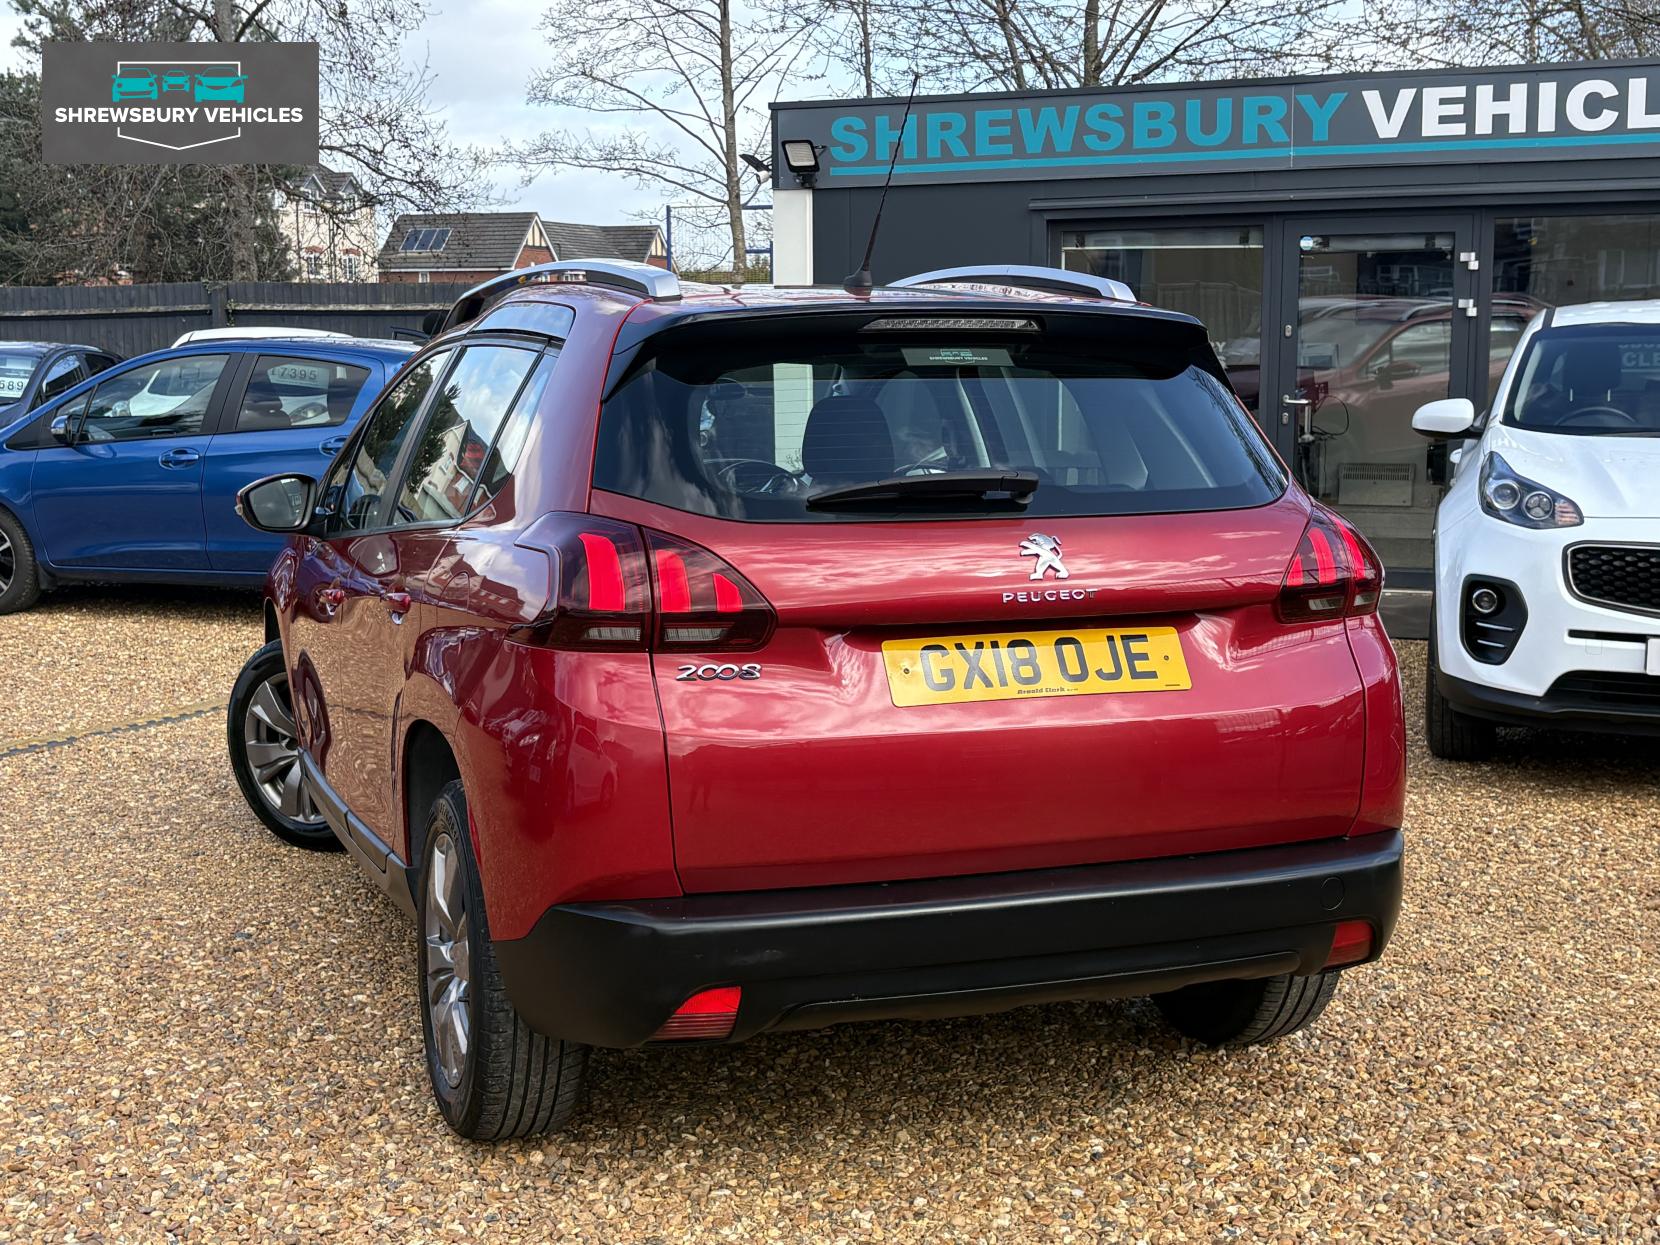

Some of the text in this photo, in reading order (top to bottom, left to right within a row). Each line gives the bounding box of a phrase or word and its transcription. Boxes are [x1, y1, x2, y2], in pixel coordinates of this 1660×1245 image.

[830, 77, 1660, 163] SHREWSBURY VEHICL
[1003, 588, 1098, 604] PEUGEOT
[676, 663, 762, 681] 2008
[919, 633, 1159, 692] GX18 OJE
